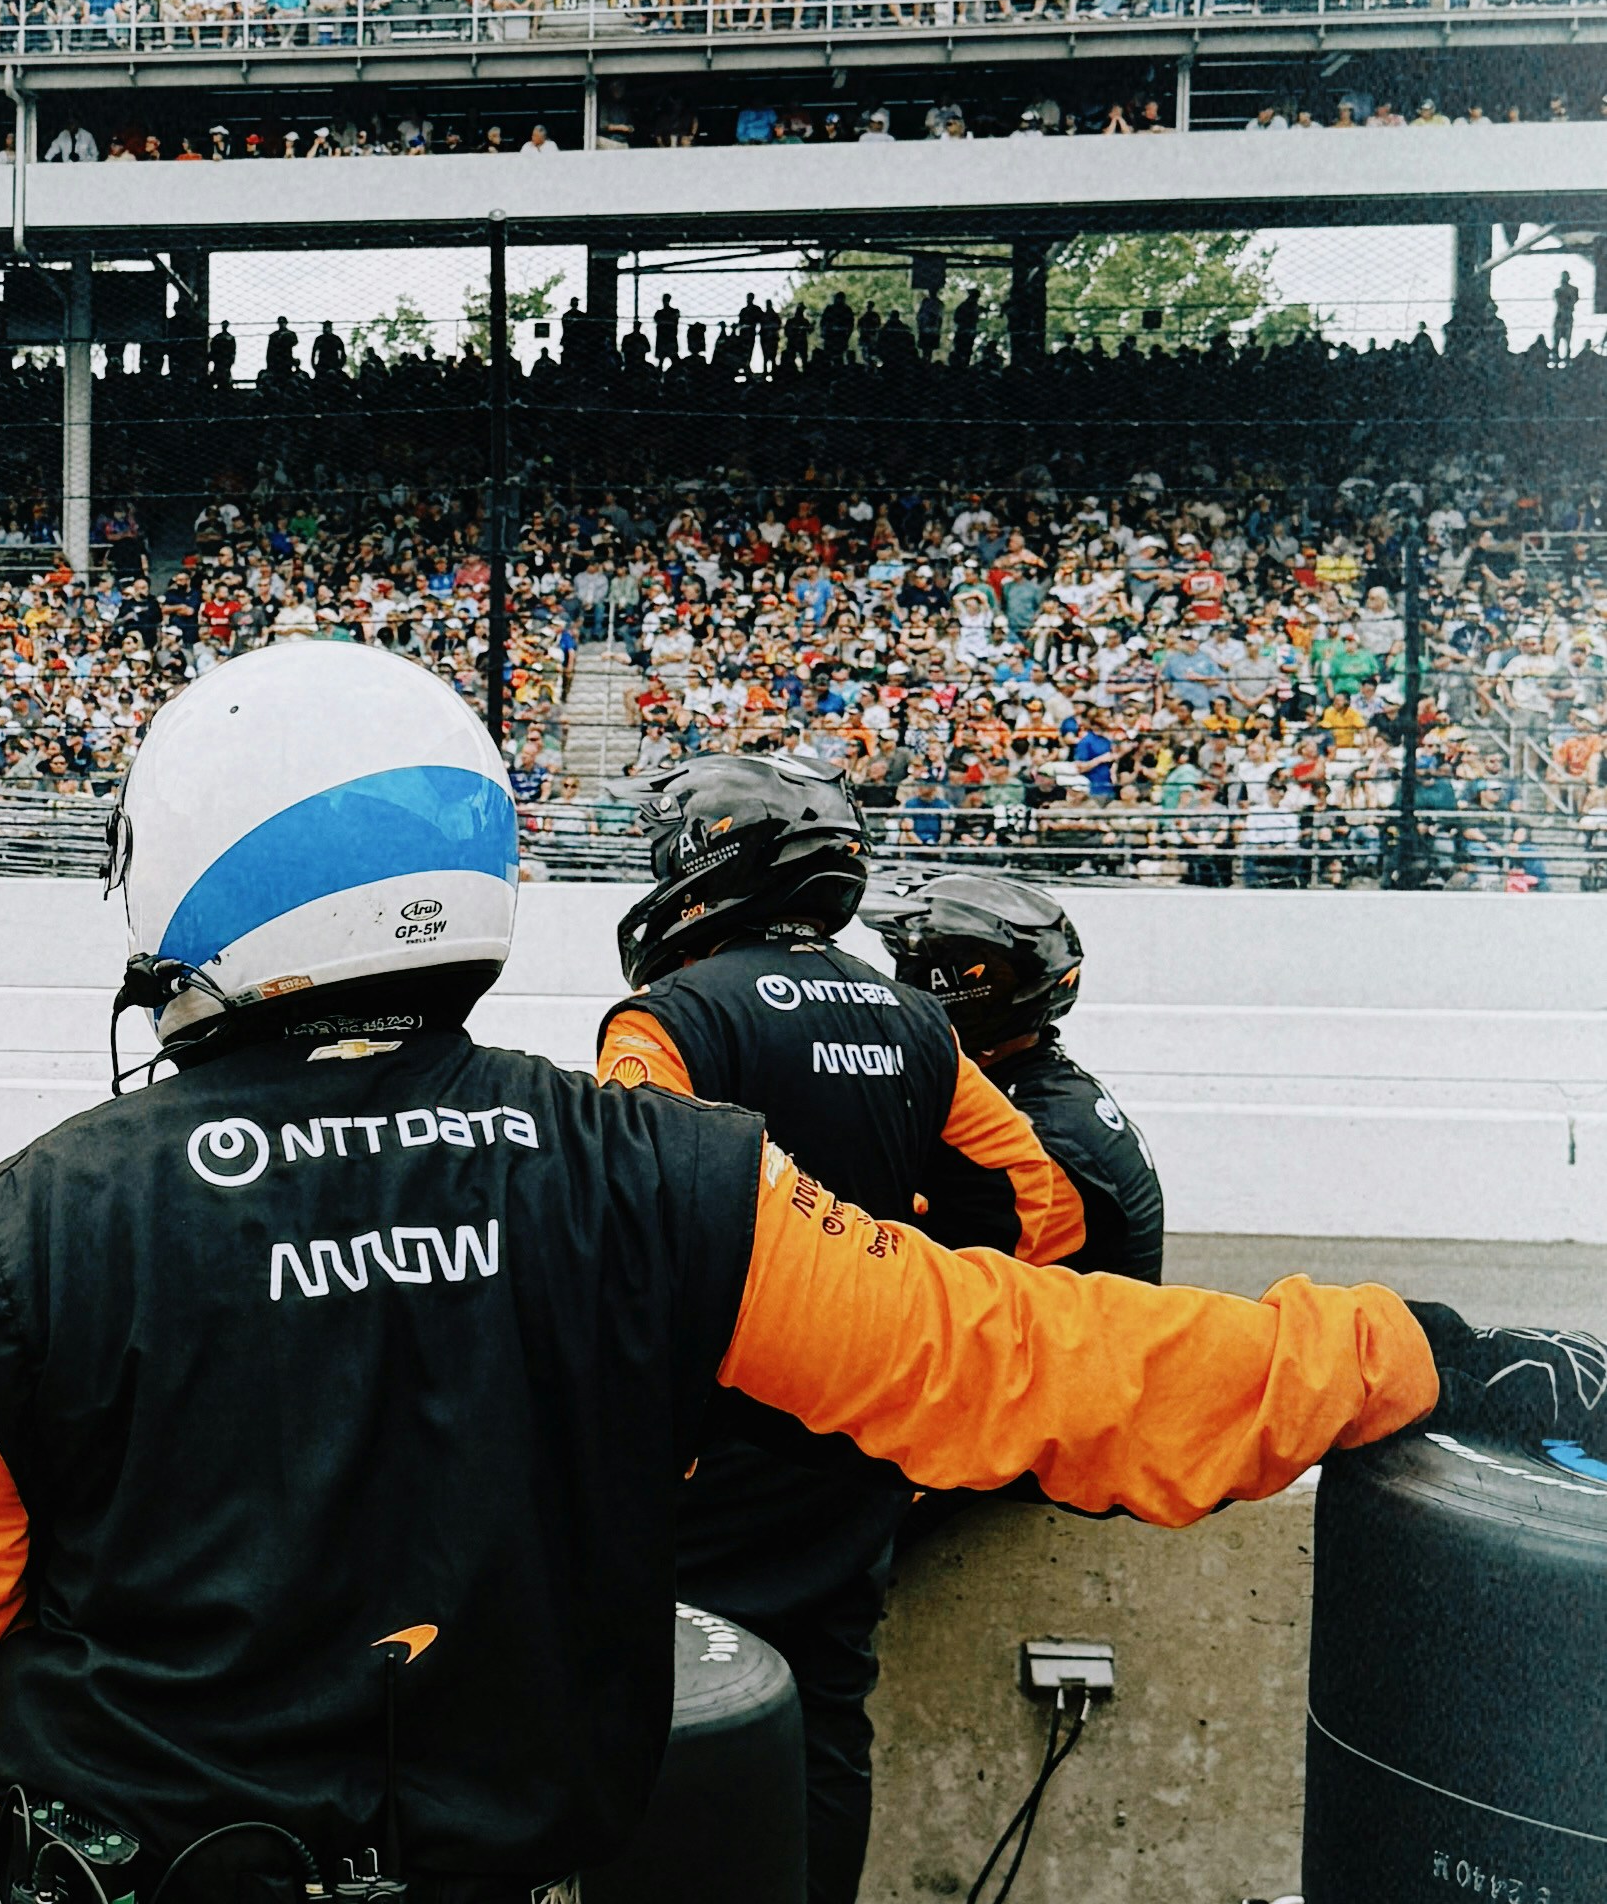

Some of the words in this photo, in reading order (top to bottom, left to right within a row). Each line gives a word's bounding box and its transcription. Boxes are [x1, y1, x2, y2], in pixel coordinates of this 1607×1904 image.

[395, 920, 447, 938] GP-5W
[280, 1117, 388, 1162] NTT
[270, 1218, 499, 1301] ARROW
